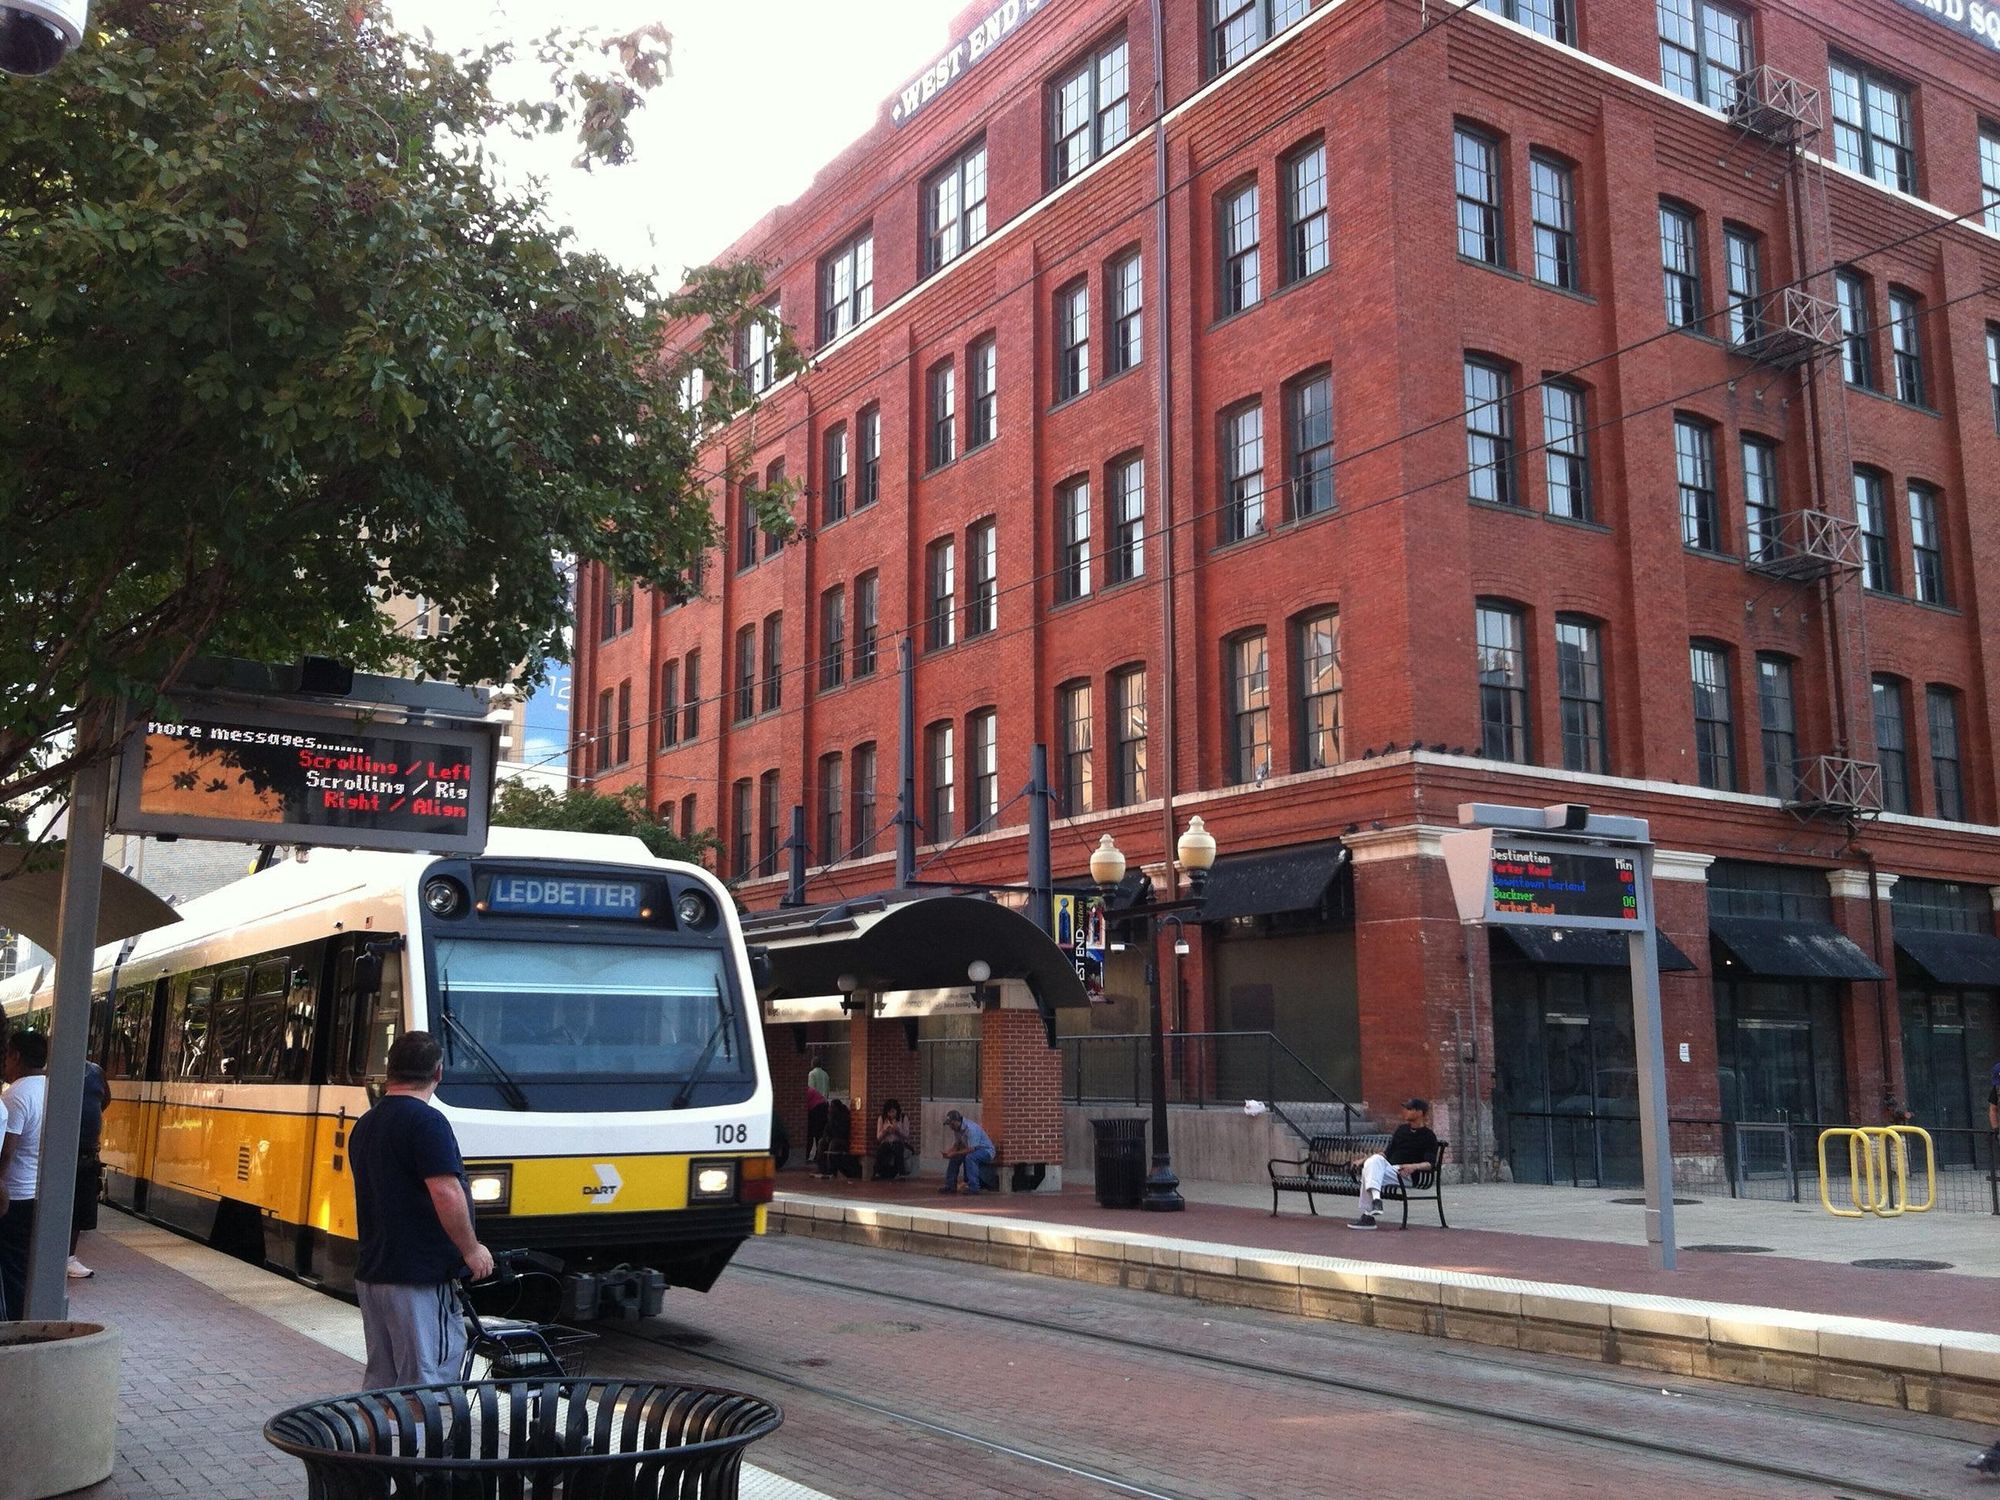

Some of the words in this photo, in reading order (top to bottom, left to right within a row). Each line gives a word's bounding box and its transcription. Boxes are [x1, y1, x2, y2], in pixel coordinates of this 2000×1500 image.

[900, 42, 963, 118] WEST
[967, 0, 1021, 63] END
[299, 749, 398, 775] Scrolling
[306, 770, 405, 795] Scrolling
[435, 781, 469, 800] Rig
[323, 790, 380, 811] Right
[412, 797, 467, 818] Align
[1490, 848, 1551, 864] Destination
[1615, 858, 1633, 871] Min
[496, 879, 637, 908] LEDBETTER
[1493, 887, 1535, 901] Buckner
[1075, 928, 1085, 957] END
[1075, 959, 1086, 981] EST
[714, 1123, 748, 1145] 108
[582, 1185, 618, 1196] DART
